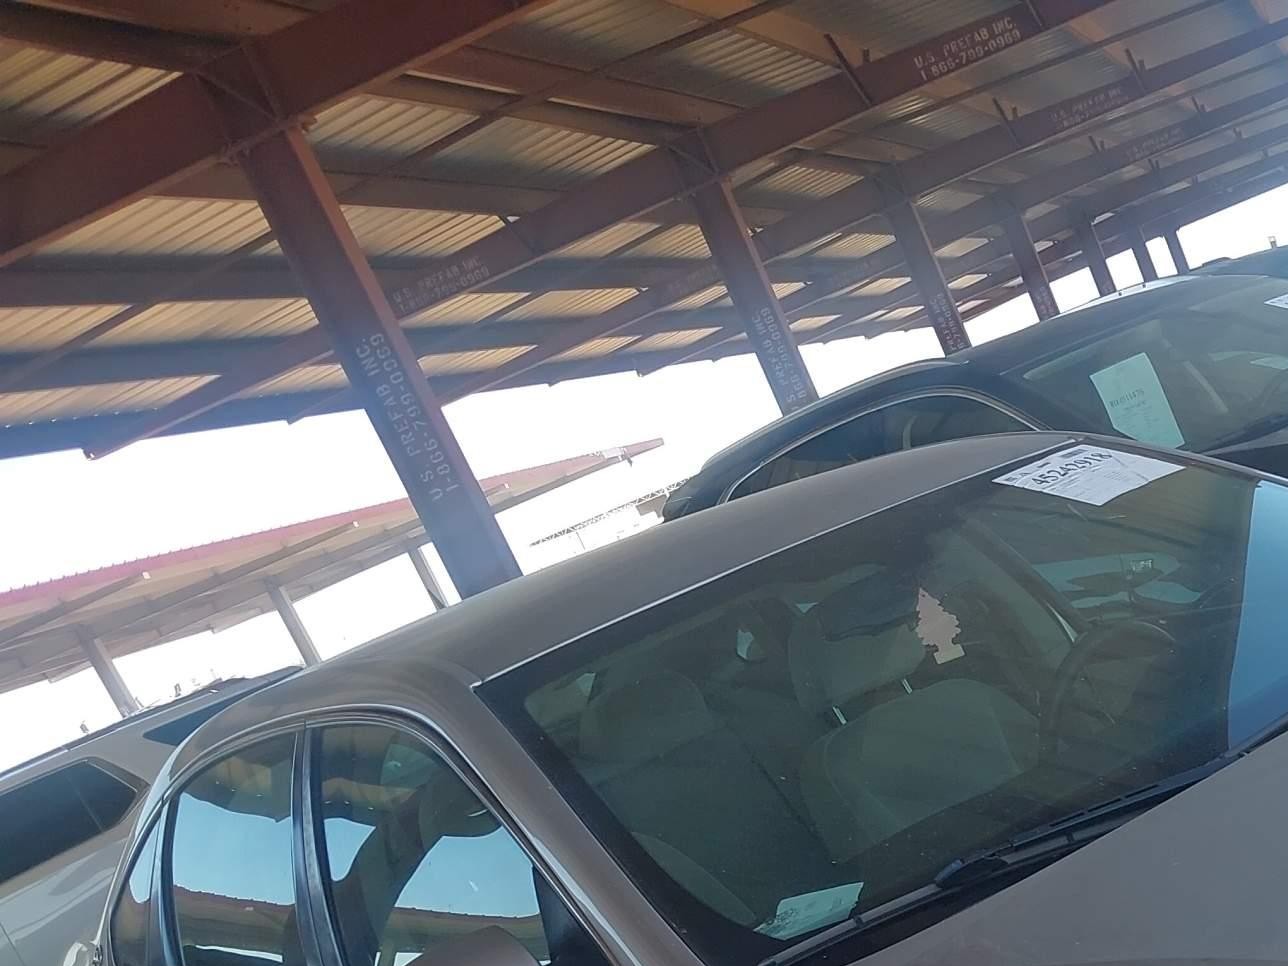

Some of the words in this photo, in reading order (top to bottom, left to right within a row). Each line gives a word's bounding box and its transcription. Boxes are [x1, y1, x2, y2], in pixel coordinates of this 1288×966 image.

[943, 27, 990, 56] PREFAB
[356, 337, 380, 378] INC.
[370, 333, 460, 493] 1-866-799-0969
[376, 383, 421, 457] PREFAB
[1031, 451, 1113, 486] 45242918
